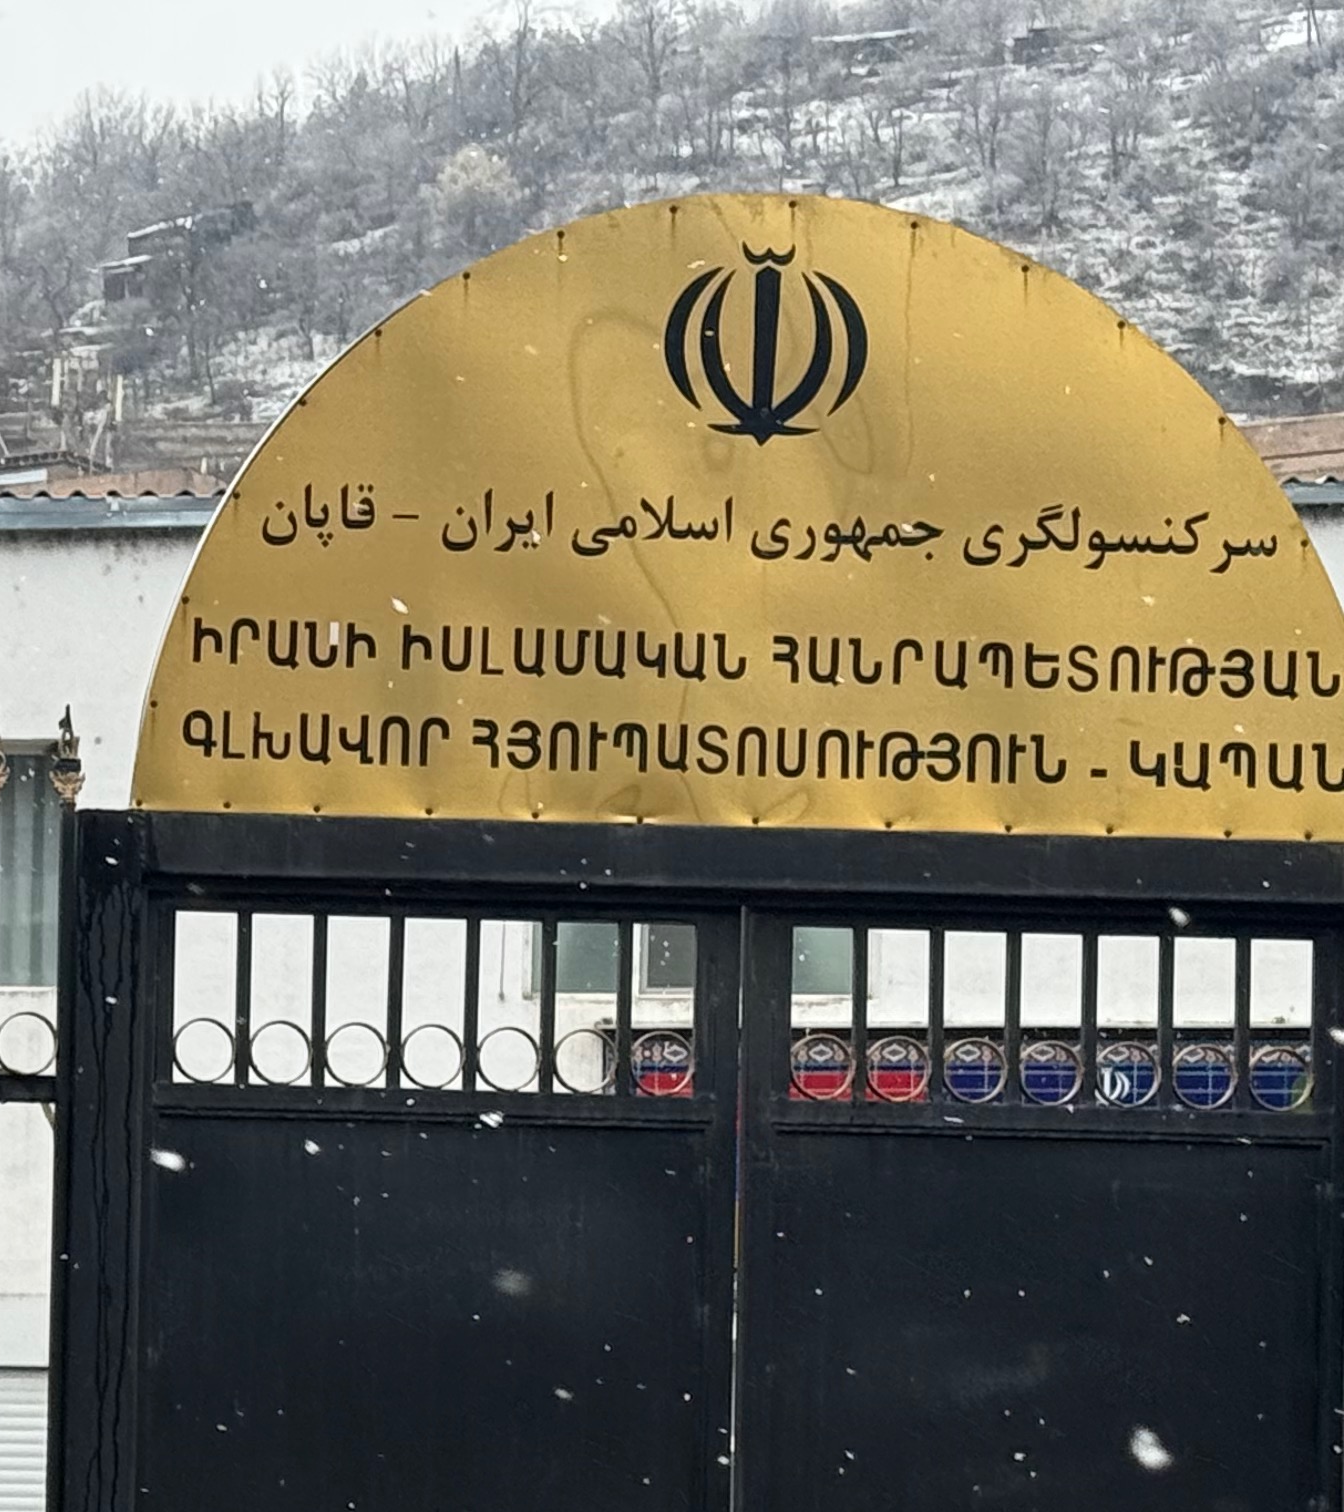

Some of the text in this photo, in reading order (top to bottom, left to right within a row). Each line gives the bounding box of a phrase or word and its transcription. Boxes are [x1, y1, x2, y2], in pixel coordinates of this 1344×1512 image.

[261, 483, 376, 549] قاپان
[441, 487, 555, 553] ایران
[571, 495, 734, 557] اسلامی
[750, 513, 944, 563] جمهوری
[192, 616, 1342, 700] ԻՐԱՆԻ ԻՍԼԱՄԱԿԱՆ ՀԱՆՐԱՊԵՏՈՒԹՅԱՆ
[182, 709, 451, 768] ԳԼԽԱՎՈՐ
[471, 718, 1068, 784] ՀՅՈՒՊԱՏՈՍՈՒԹՅՈՒՆ
[1129, 739, 1344, 793] ԿԱՊԱՆ
